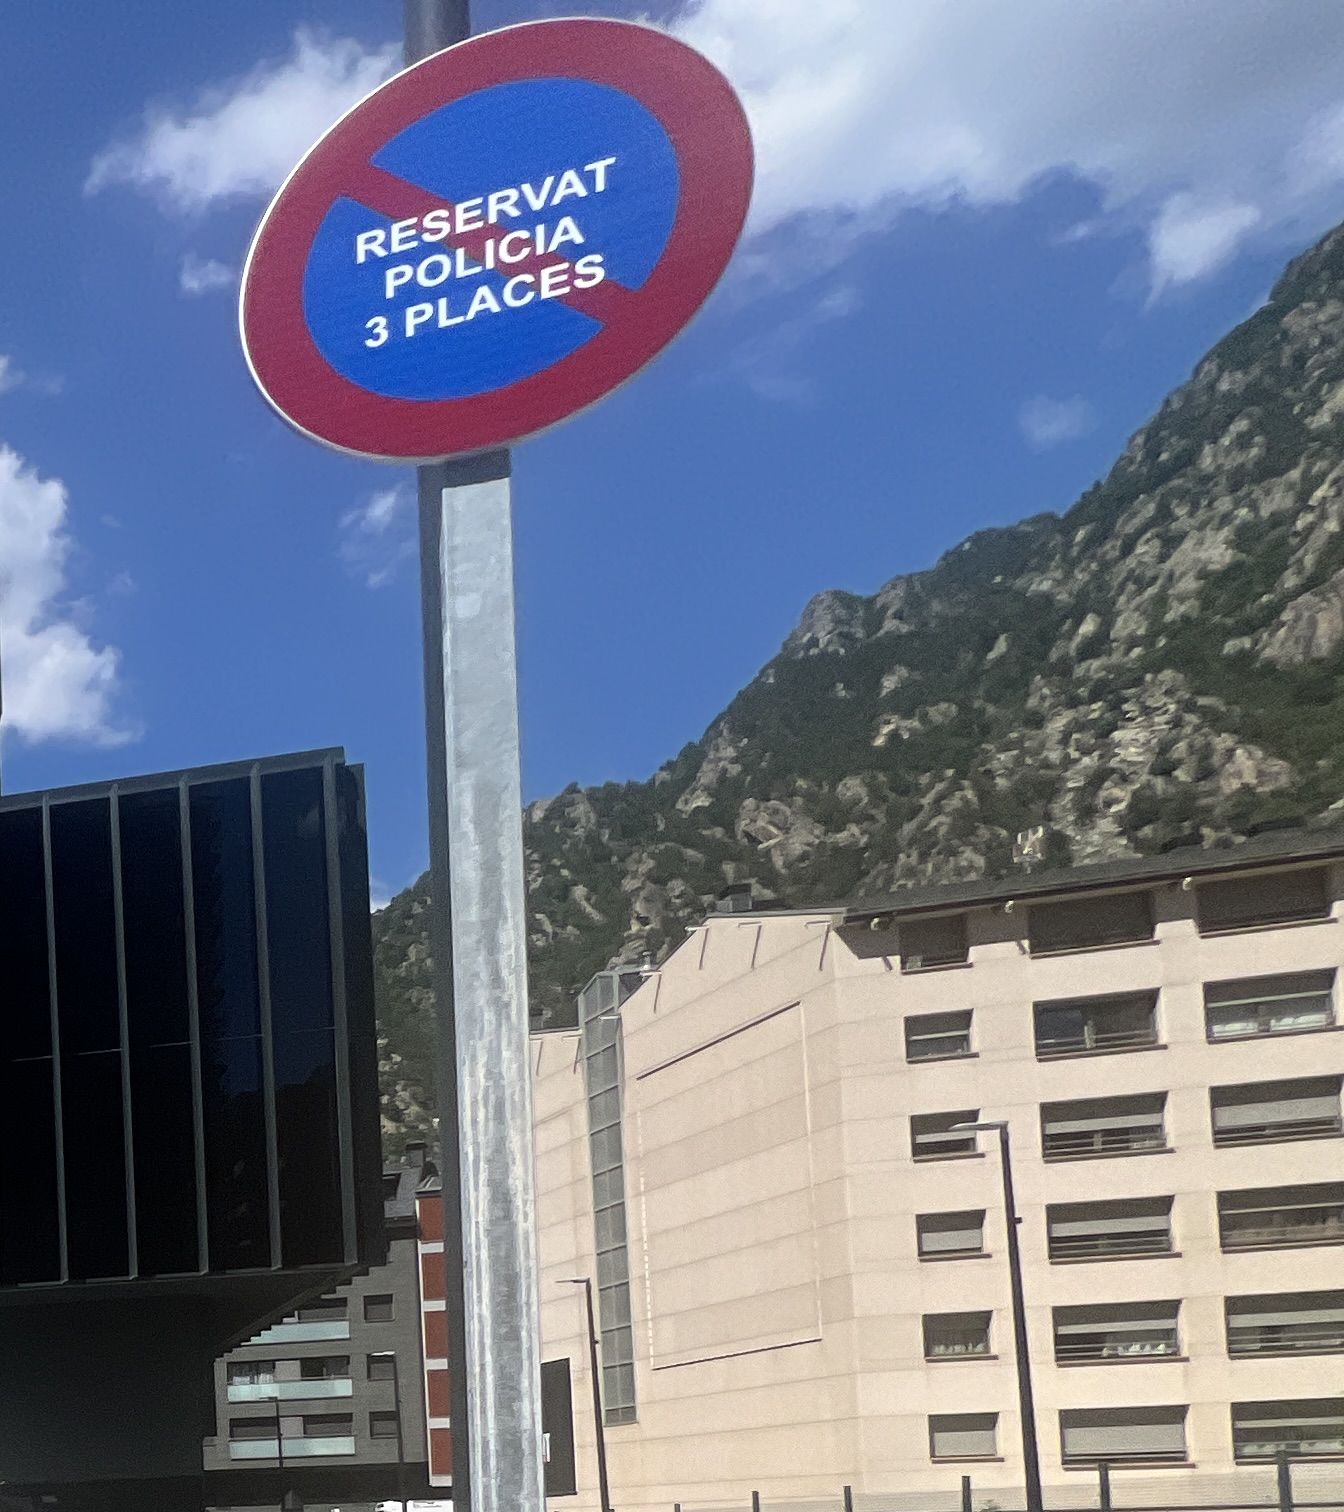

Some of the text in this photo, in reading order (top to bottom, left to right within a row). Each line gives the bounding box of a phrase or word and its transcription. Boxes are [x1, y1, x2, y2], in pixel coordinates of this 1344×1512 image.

[355, 157, 616, 265] RESERVAT
[384, 216, 584, 299] POLICIA
[364, 253, 606, 348] 3 PLACES
